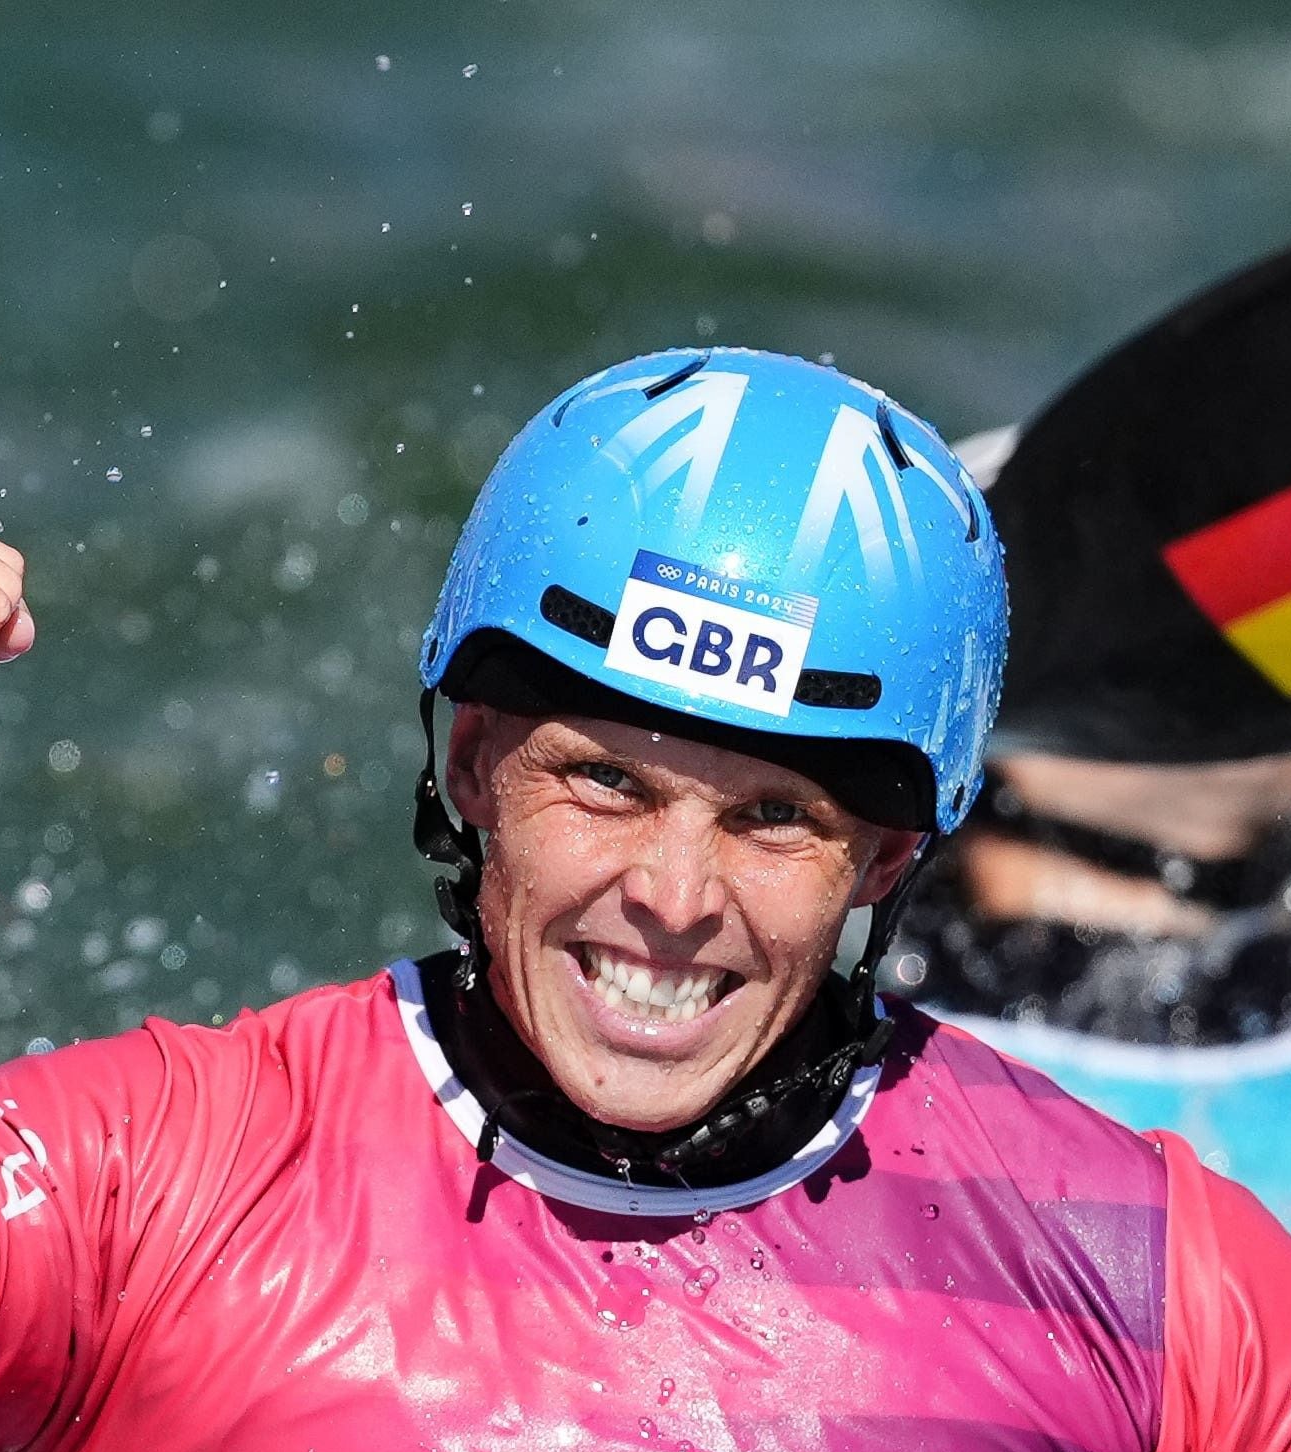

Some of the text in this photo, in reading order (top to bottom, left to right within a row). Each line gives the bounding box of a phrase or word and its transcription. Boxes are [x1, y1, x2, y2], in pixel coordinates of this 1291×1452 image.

[685, 571, 795, 614] PARIS 2024
[631, 606, 784, 693] GBR
